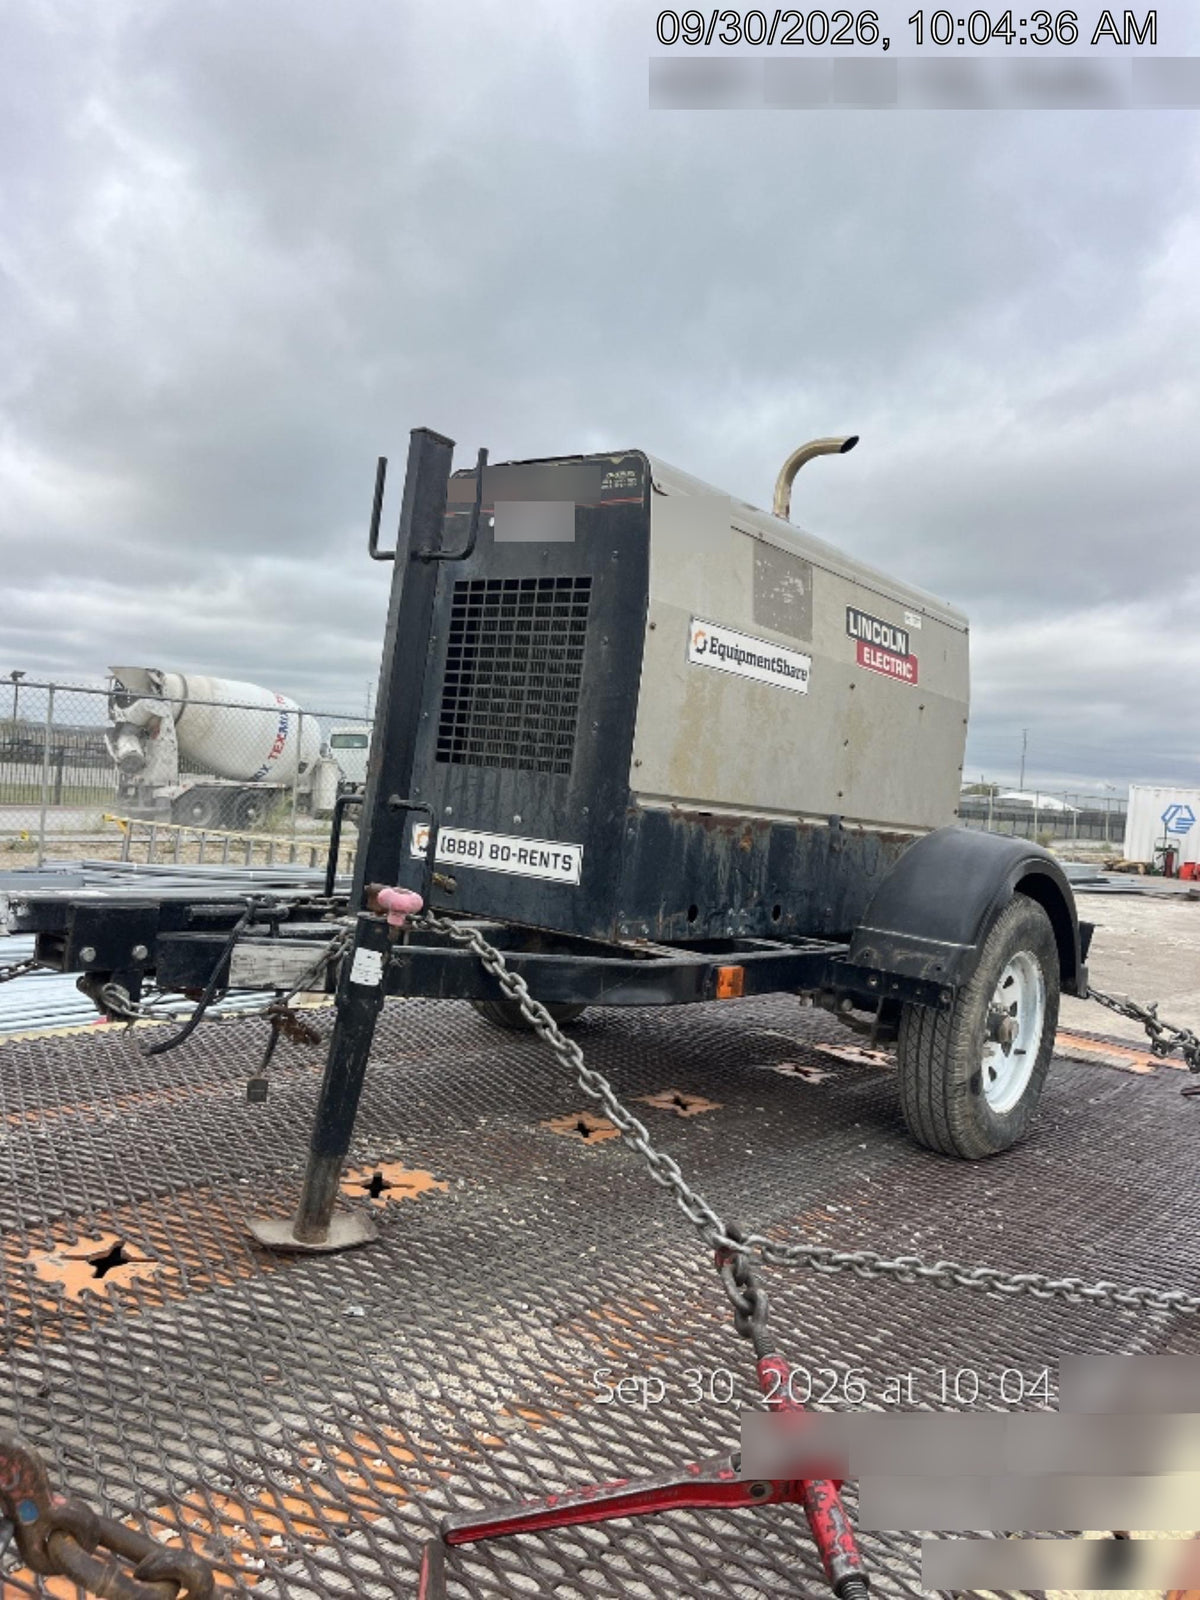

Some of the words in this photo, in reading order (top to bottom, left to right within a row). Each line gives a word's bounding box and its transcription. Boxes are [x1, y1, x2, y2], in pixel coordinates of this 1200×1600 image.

[849, 612, 907, 654] LINCOLN
[708, 636, 808, 682] EquipmentShare
[863, 646, 913, 680] ELECTRIC
[440, 835, 484, 859] (888)
